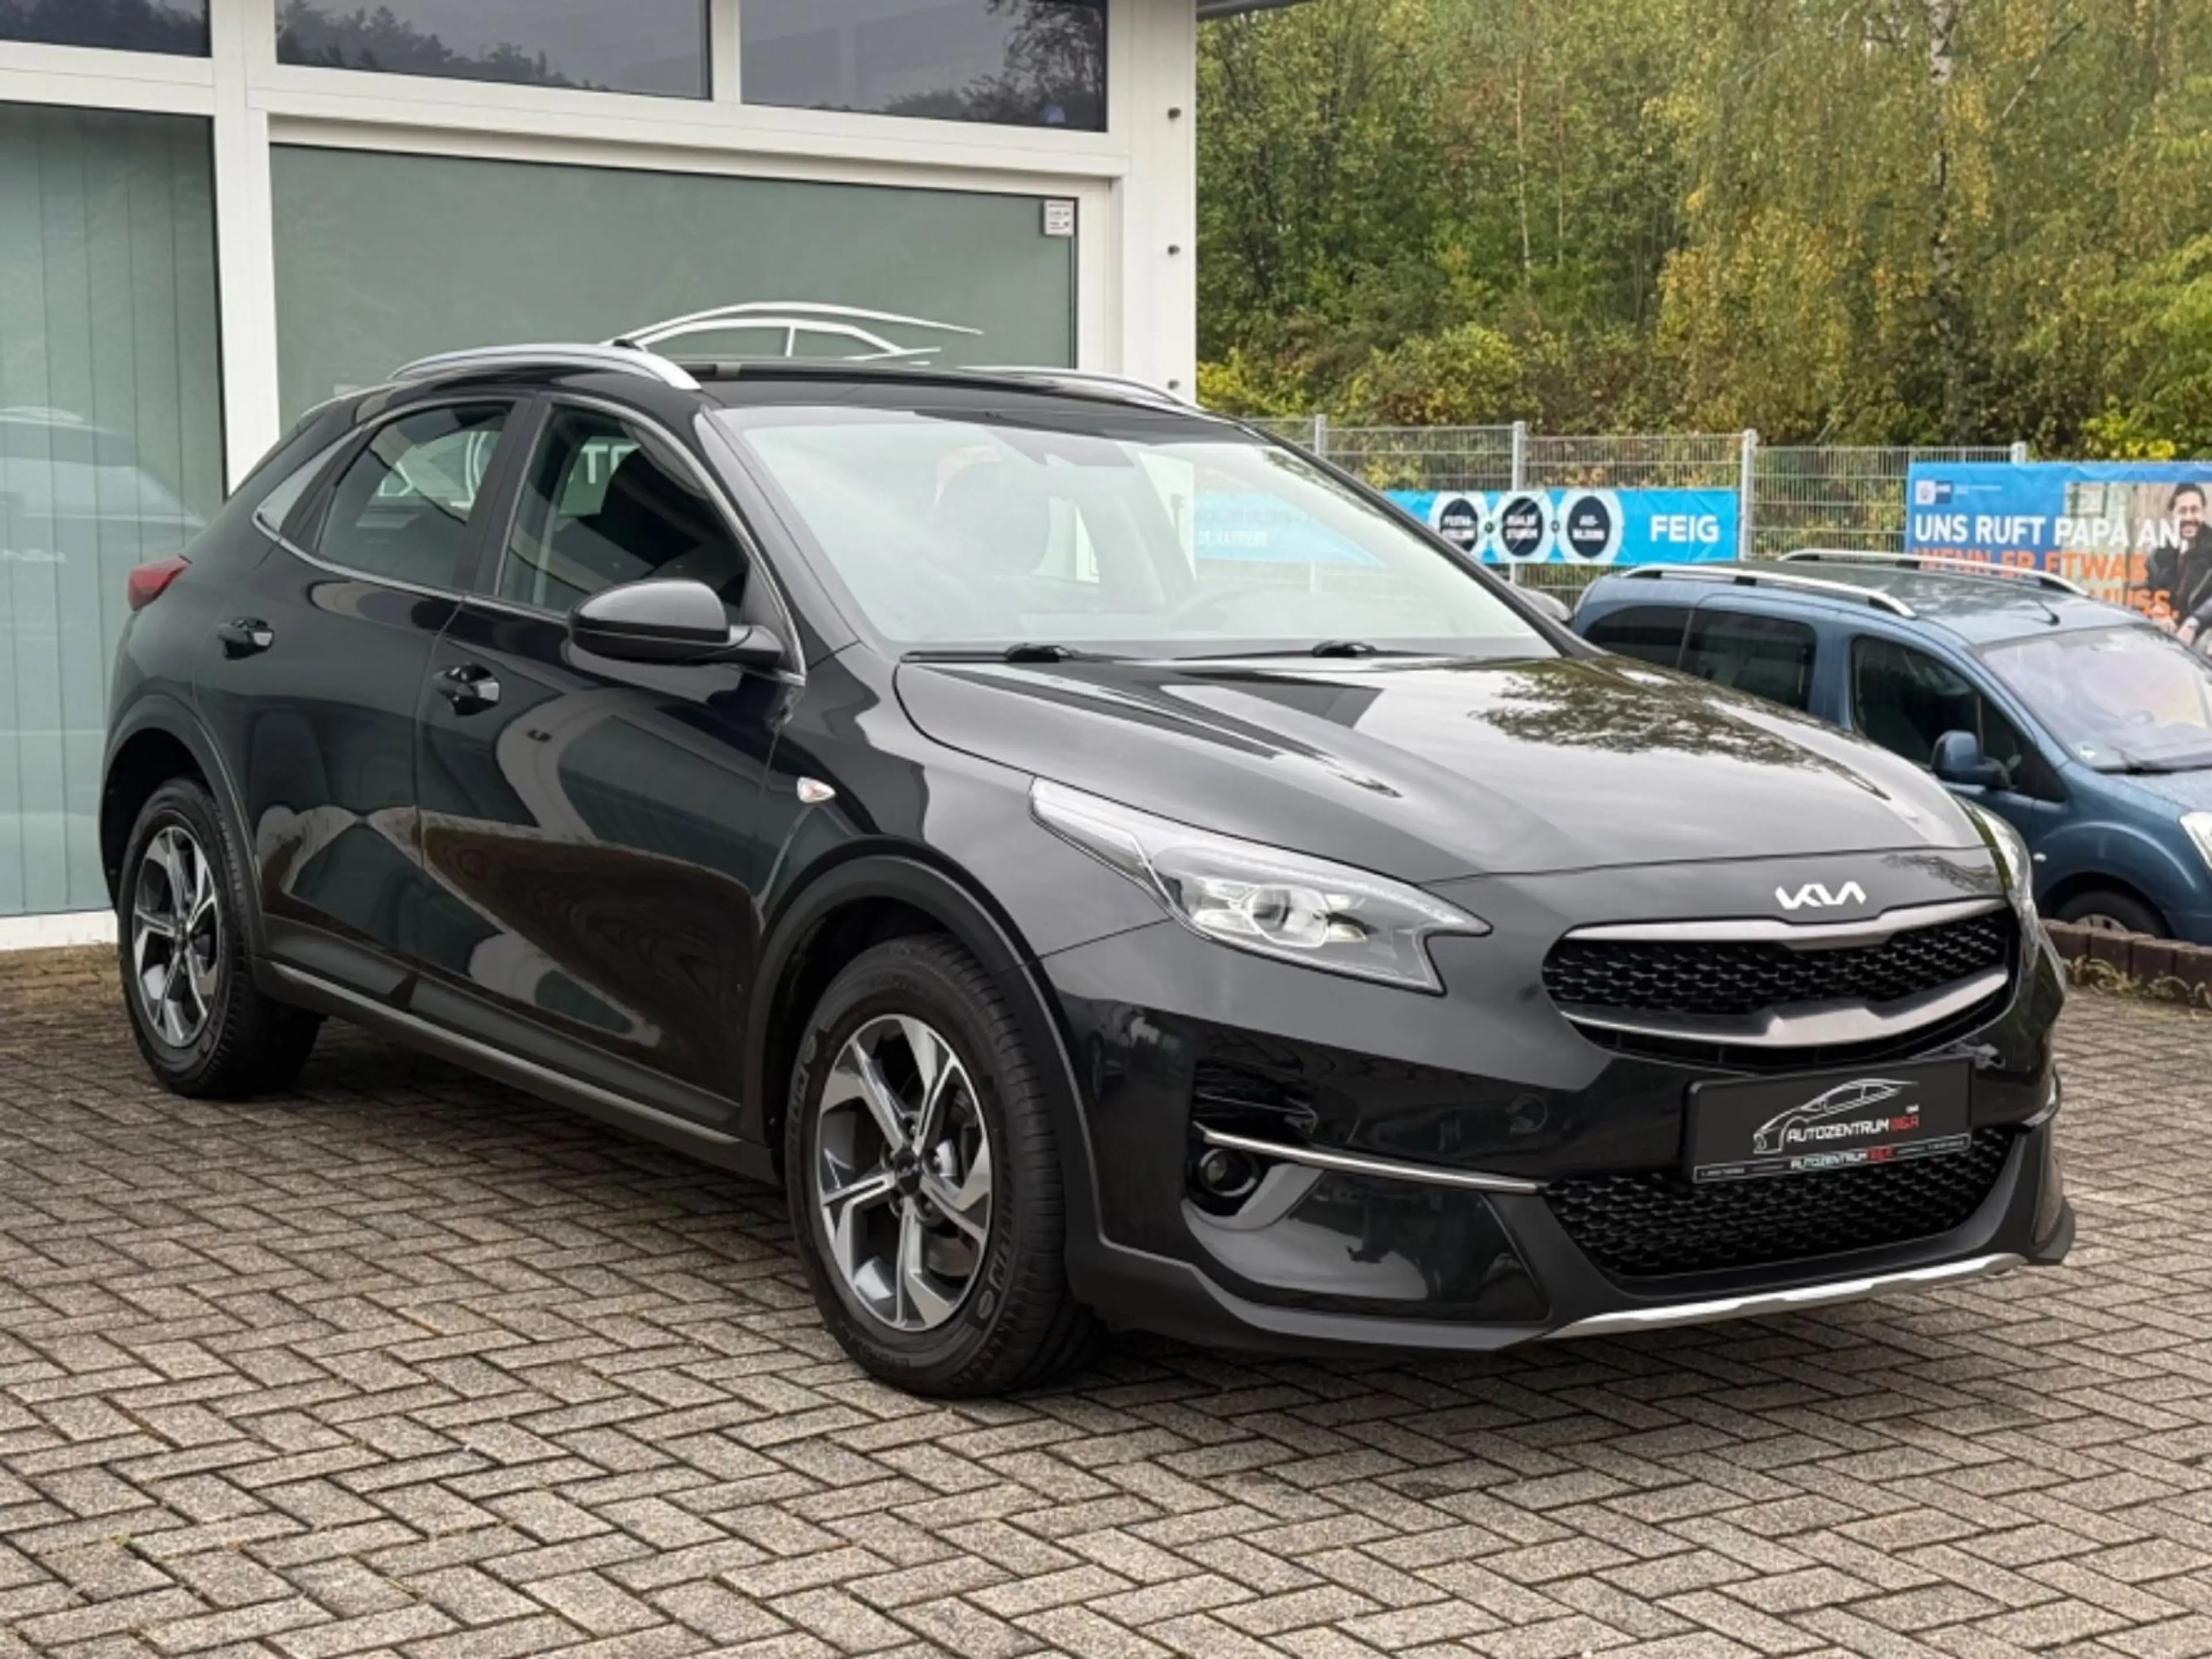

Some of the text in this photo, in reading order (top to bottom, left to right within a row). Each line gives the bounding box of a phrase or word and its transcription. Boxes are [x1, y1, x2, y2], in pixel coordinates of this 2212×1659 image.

[1650, 514, 1719, 543] FEIG
[1915, 513, 1969, 544] UNS
[1975, 515, 2046, 546] RUFT
[2054, 517, 2130, 548] PAPA
